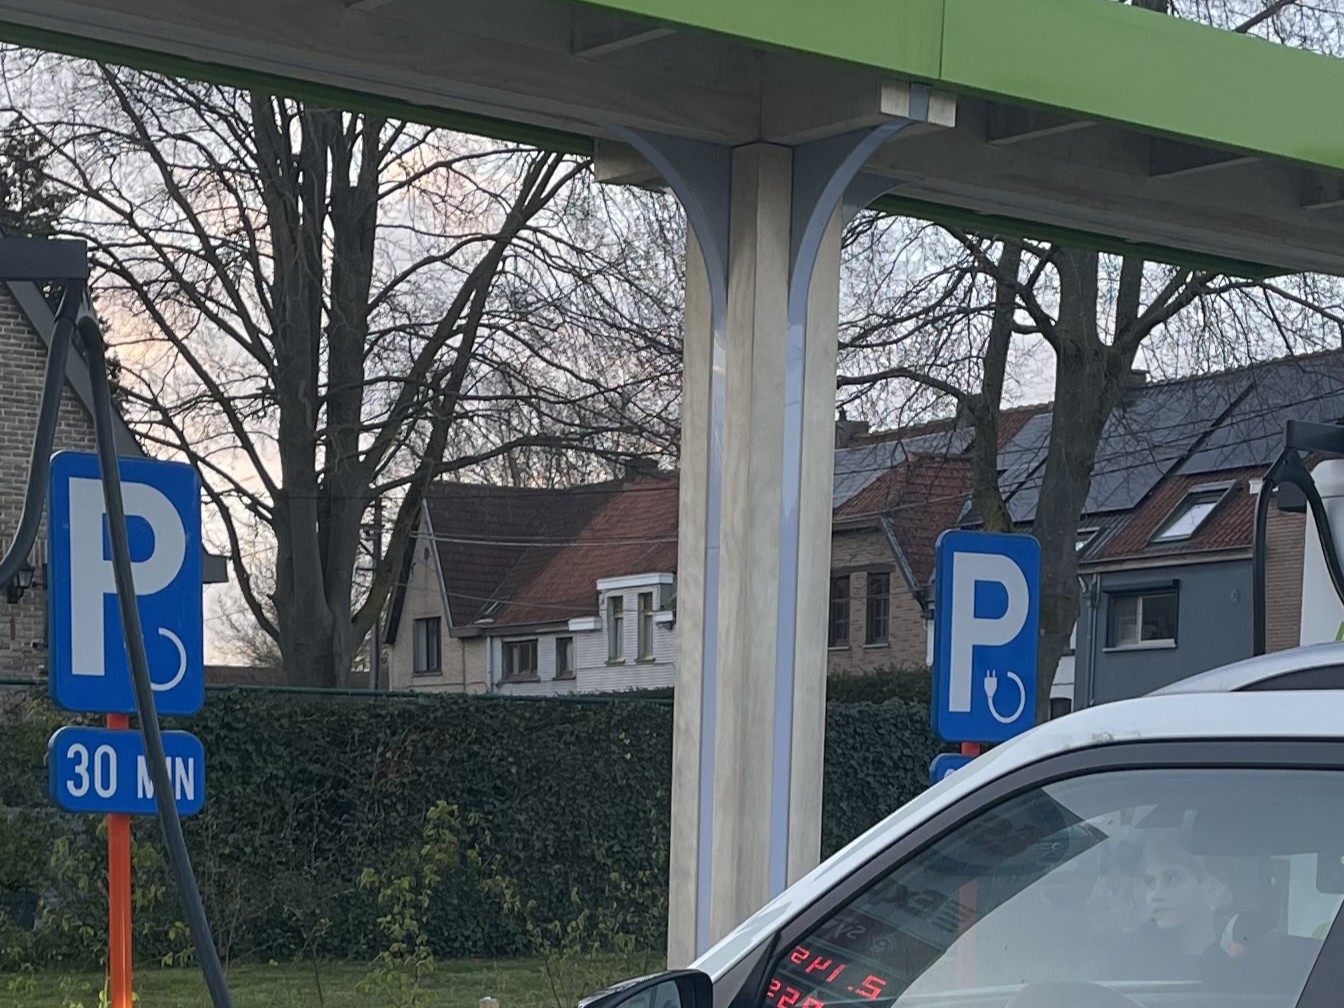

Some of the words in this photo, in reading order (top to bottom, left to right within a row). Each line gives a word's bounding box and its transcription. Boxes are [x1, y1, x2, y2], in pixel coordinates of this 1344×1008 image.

[68, 477, 186, 677] P
[949, 552, 1030, 713] P
[66, 743, 118, 798] 30
